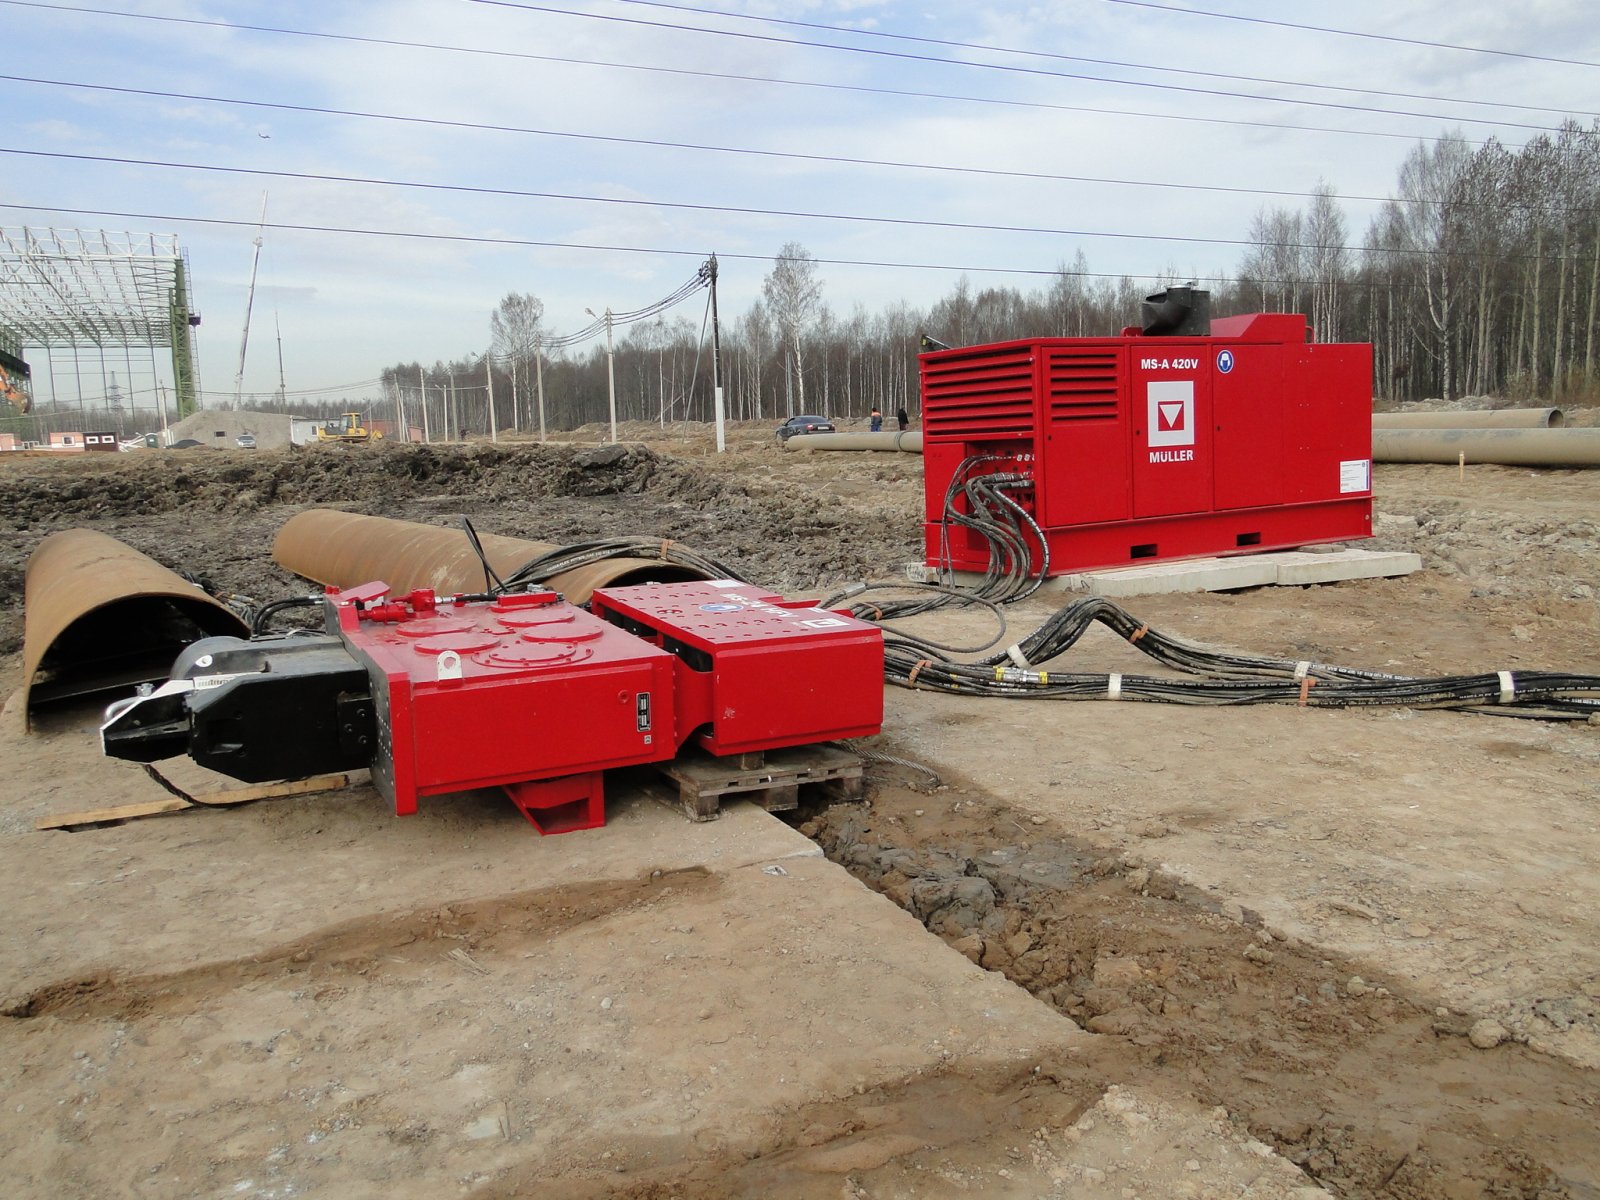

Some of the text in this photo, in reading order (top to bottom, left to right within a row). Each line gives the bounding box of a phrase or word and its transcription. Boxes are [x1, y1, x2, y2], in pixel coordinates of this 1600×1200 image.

[1141, 358, 1199, 370] MS-A 420V
[1149, 449, 1194, 463] MÜLLER
